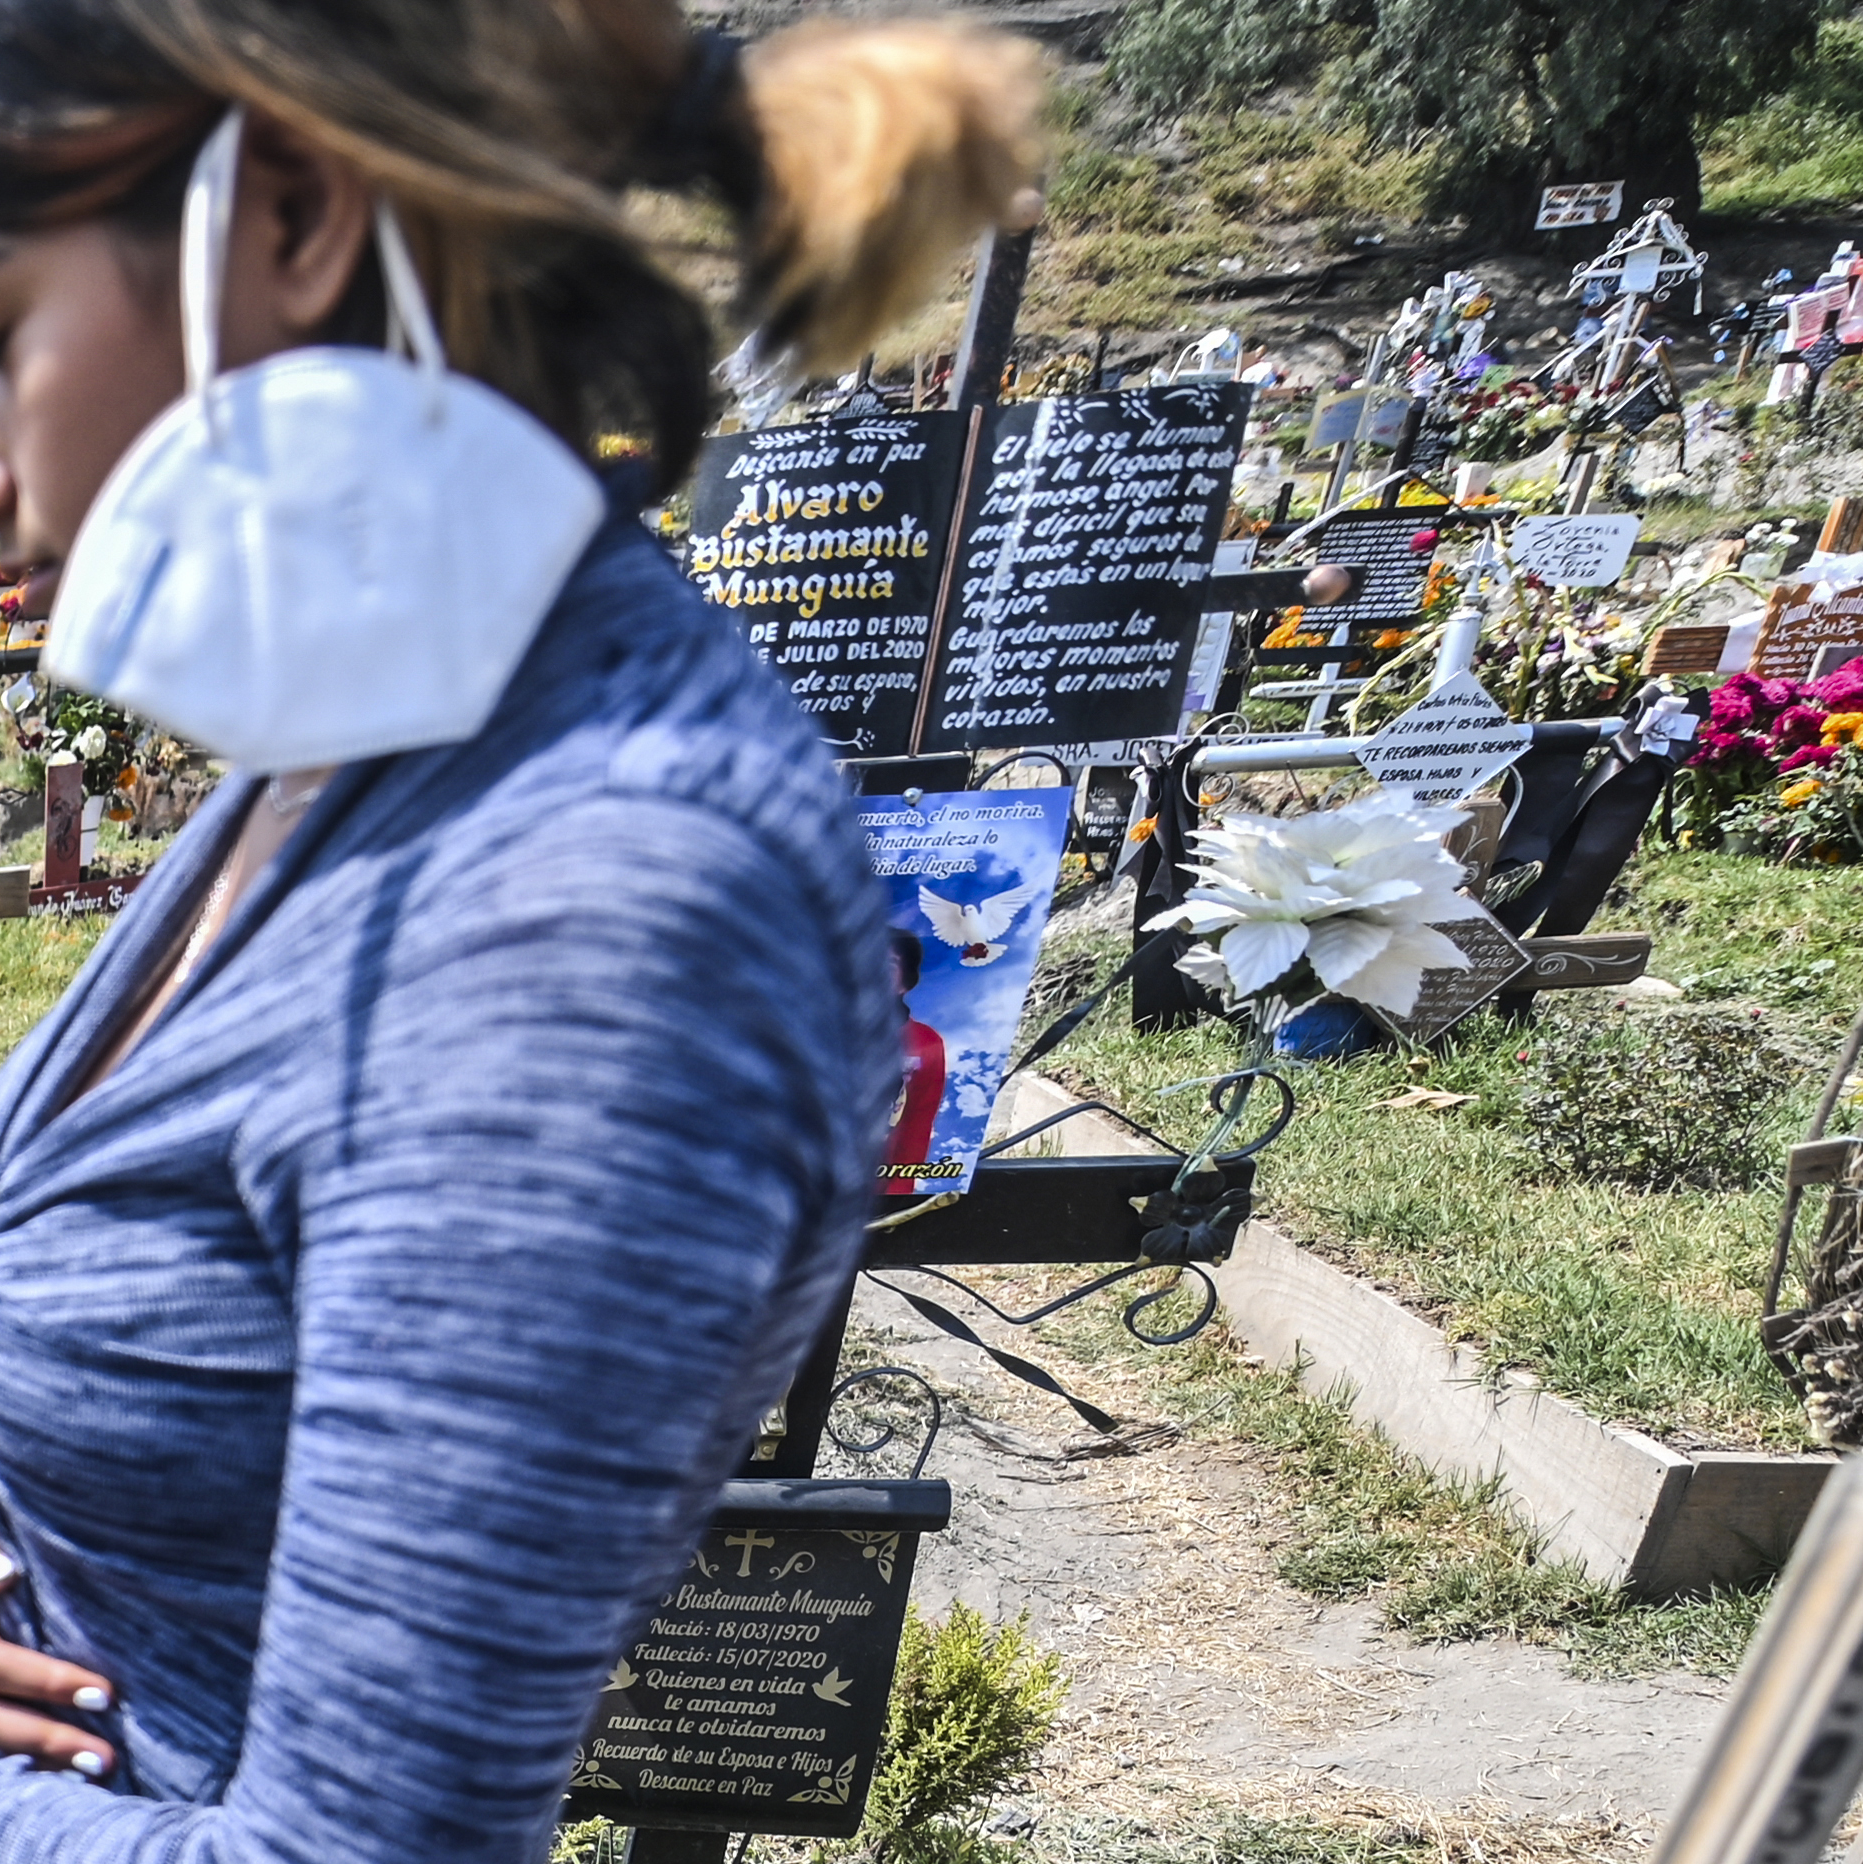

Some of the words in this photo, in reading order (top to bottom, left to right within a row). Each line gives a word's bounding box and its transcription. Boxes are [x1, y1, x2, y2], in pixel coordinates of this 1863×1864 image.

[846, 443, 877, 465] en
[878, 442, 927, 473] paz
[992, 435, 1026, 464] El
[1095, 430, 1132, 451] se
[1051, 456, 1083, 482] la
[1086, 448, 1185, 480] llegada
[1184, 472, 1219, 497] Por
[1124, 505, 1172, 535] que
[688, 514, 929, 576] Bustamante
[1086, 531, 1183, 561] seguros
[1098, 563, 1127, 582] en
[1134, 560, 1166, 580] un
[695, 559, 895, 618] Munguía
[750, 621, 779, 643] DE
[788, 619, 861, 640] MARZO
[866, 617, 891, 636] DE
[894, 615, 928, 636] 1970
[1121, 608, 1156, 638] los
[776, 643, 840, 664] JULIO
[846, 642, 881, 660] DEL
[882, 639, 925, 659] 2020
[1058, 638, 1180, 668] momentos
[790, 670, 821, 694] de
[826, 675, 852, 693] su
[853, 671, 918, 700] esposa,
[1055, 674, 1083, 693] en
[1087, 664, 1172, 692] nuestro
[862, 694, 875, 714] y
[941, 699, 1055, 729] corazón.
[1051, 741, 1099, 761] SRA.
[1363, 747, 1382, 763] TE
[1382, 742, 1477, 762] RECORDAREMOS
[1477, 739, 1529, 755] SIEMPRE
[1426, 767, 1463, 780] HIJOS
[927, 803, 948, 824] el
[949, 809, 971, 822] no
[882, 830, 980, 850] naturaleza
[982, 829, 1000, 845] lo
[897, 855, 921, 874] de
[922, 854, 977, 879] lugar.
[875, 1155, 963, 1178] orazón
[676, 1584, 787, 1613] Bustamante
[788, 1589, 875, 1623] Munguía
[650, 1618, 711, 1637] Nació:
[715, 1621, 821, 1645] 18/03/1970
[635, 1643, 711, 1663] Falleció:
[716, 1648, 827, 1671] 15/07/2020
[646, 1668, 725, 1691] Quienes
[730, 1679, 752, 1692] en
[758, 1675, 806, 1695] vida
[687, 1699, 776, 1717] amamos
[608, 1715, 672, 1733] nunca
[698, 1720, 826, 1742] olvidaremos
[592, 1738, 668, 1762] Recuerdo
[672, 1746, 692, 1763] de
[697, 1752, 715, 1765] su
[718, 1746, 774, 1771] Esposa
[777, 1758, 787, 1770] e
[791, 1751, 833, 1777] Hijos
[639, 1769, 714, 1793] Descance
[718, 1778, 736, 1794] en
[741, 1775, 774, 1797] Paz
